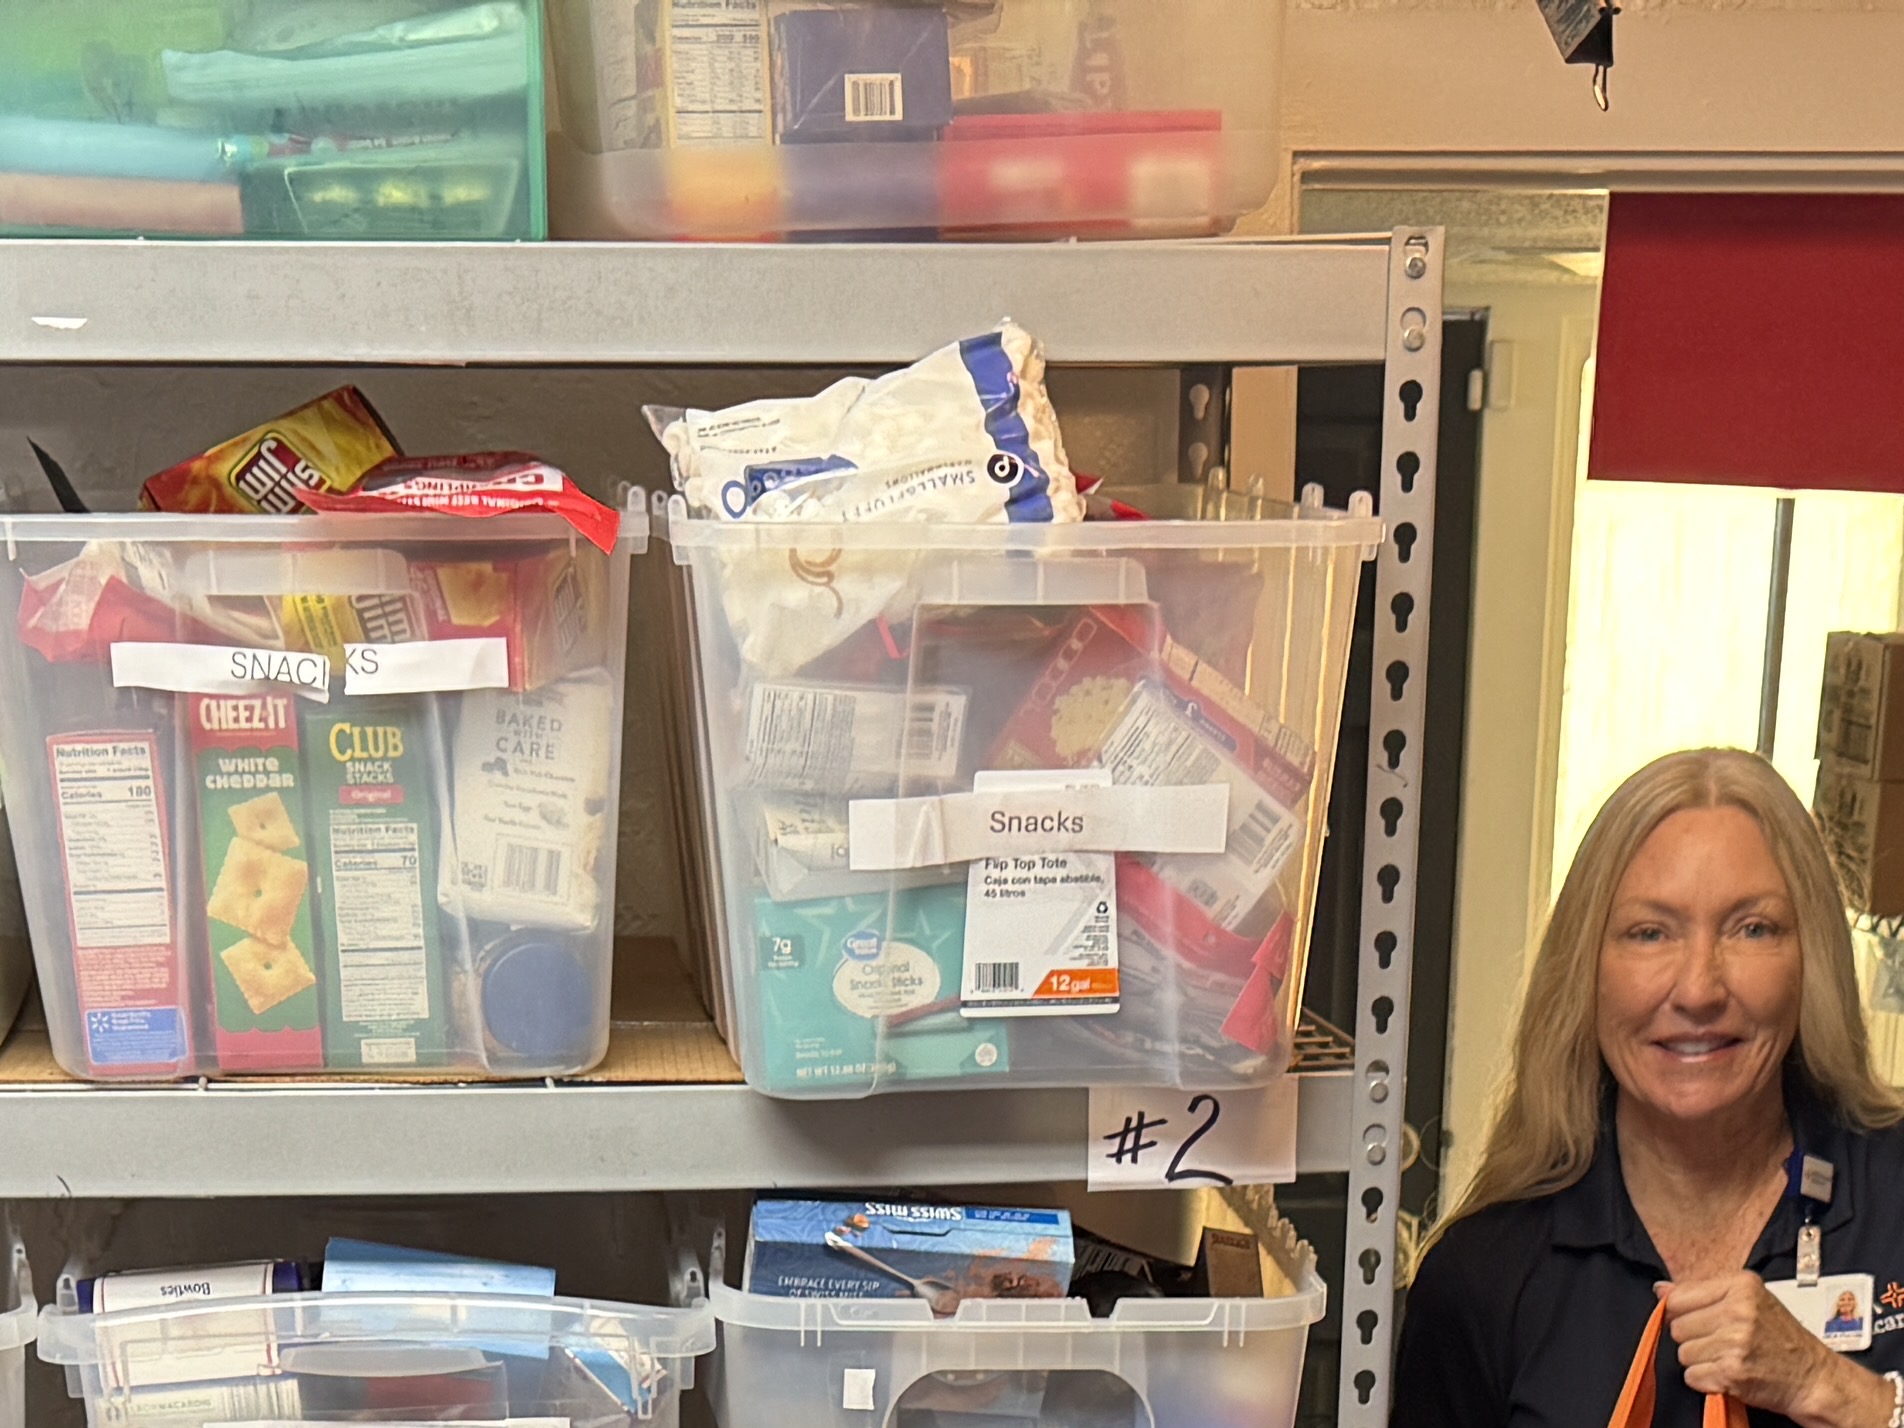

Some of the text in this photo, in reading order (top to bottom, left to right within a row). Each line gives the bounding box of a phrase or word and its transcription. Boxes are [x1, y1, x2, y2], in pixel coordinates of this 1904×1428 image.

[200, 697, 288, 730] CHEEZ-IT
[496, 709, 563, 733] BAKED
[329, 722, 404, 762] CLUB
[496, 736, 556, 761] CARE
[346, 761, 393, 772] SNACK
[989, 810, 1085, 835] Snacks
[1013, 858, 1037, 872] Top
[1041, 857, 1067, 870] Tote
[771, 936, 792, 955] 7g
[160, 1282, 213, 1298] Bowties
